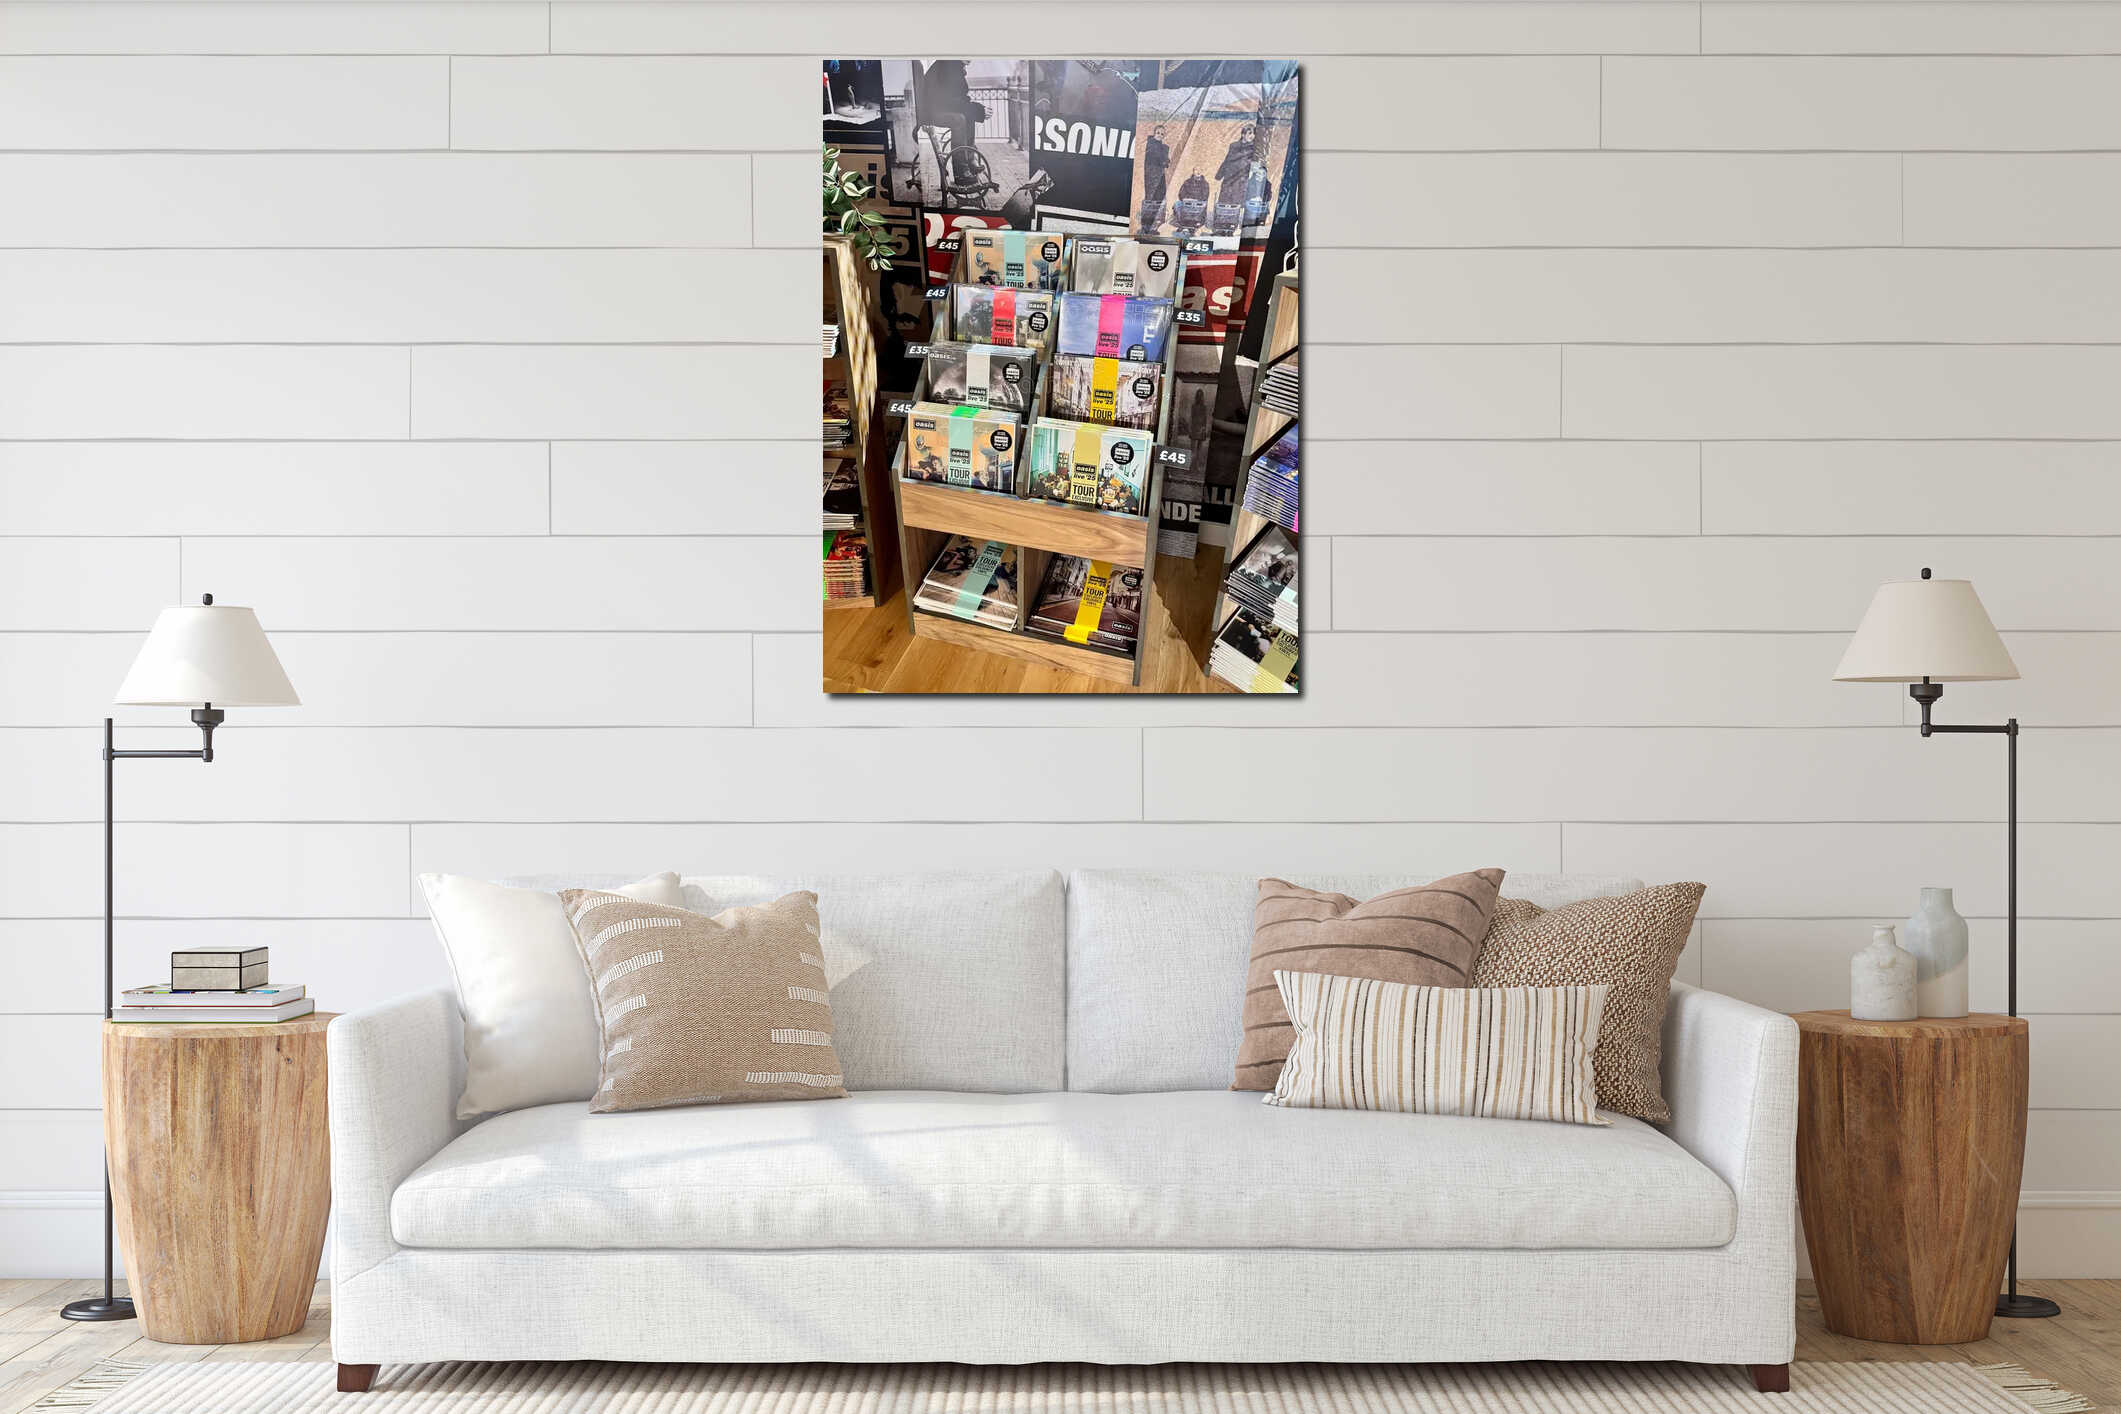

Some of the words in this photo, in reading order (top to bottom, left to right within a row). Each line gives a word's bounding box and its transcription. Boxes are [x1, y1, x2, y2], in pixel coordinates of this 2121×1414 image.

[1035, 116, 1135, 159] SONI
[938, 241, 959, 250] £45
[1080, 245, 1110, 254] oasis
[1186, 243, 1209, 252] £45
[926, 289, 946, 298] £45
[1176, 311, 1201, 322] £35
[908, 345, 928, 355] £35
[929, 352, 951, 360] oasis
[890, 403, 912, 413] £45
[1092, 409, 1113, 420] TOUR
[915, 421, 934, 429] oasis
[1160, 450, 1187, 464] £45
[950, 468, 970, 479] TOUR
[1076, 465, 1095, 473] oasis
[1073, 484, 1096, 497] TOUR
[981, 556, 999, 566] TOUR
[1086, 587, 1105, 597] TOUR
[1281, 632, 1298, 648] TOU
